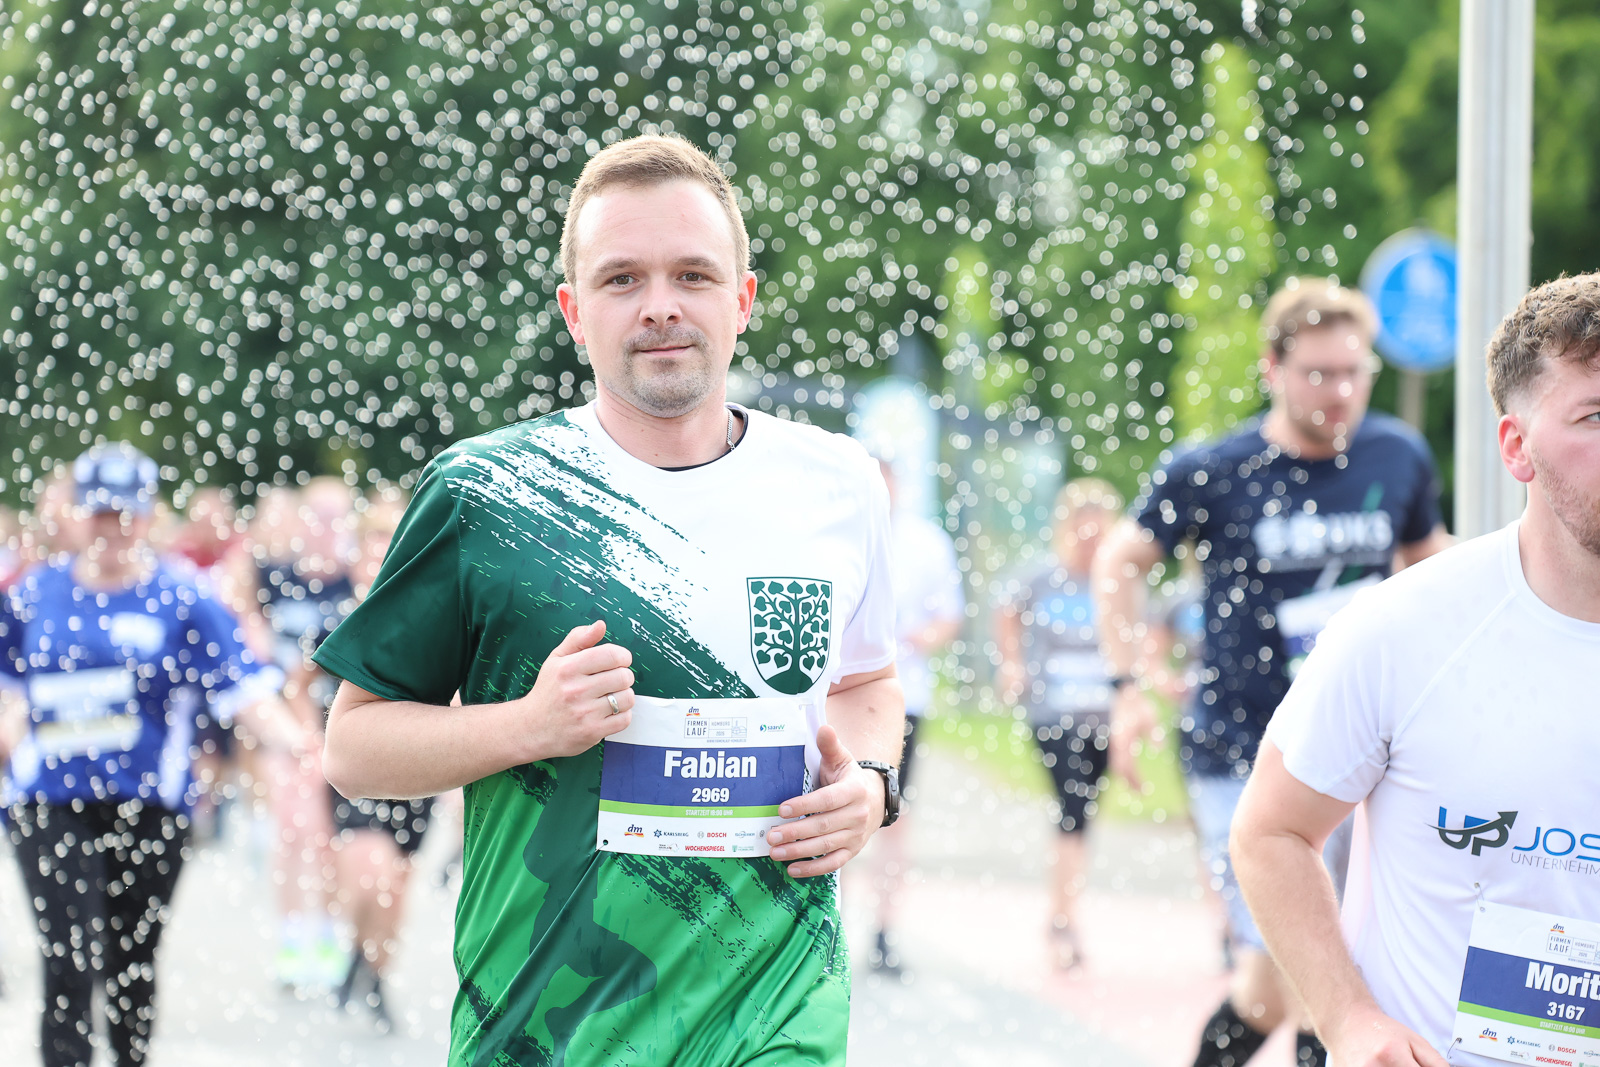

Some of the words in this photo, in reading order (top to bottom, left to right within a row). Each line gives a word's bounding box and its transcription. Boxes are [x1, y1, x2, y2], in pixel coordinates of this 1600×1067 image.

[686, 727, 707, 736] LAUF
[663, 750, 758, 779] Fabian
[691, 787, 730, 803] 2969
[1550, 935, 1571, 945] FIRMEN
[1548, 942, 1569, 953] LAUF
[1525, 961, 1600, 1001] Morit
[1546, 1001, 1586, 1021] 3167
[1539, 1021, 1563, 1031] STARTZEIT
[1516, 1039, 1541, 1048] KARLSBERG
[1557, 1046, 1577, 1054] BOSCH
[1535, 1056, 1572, 1067] WOCHENSPIEGEL
